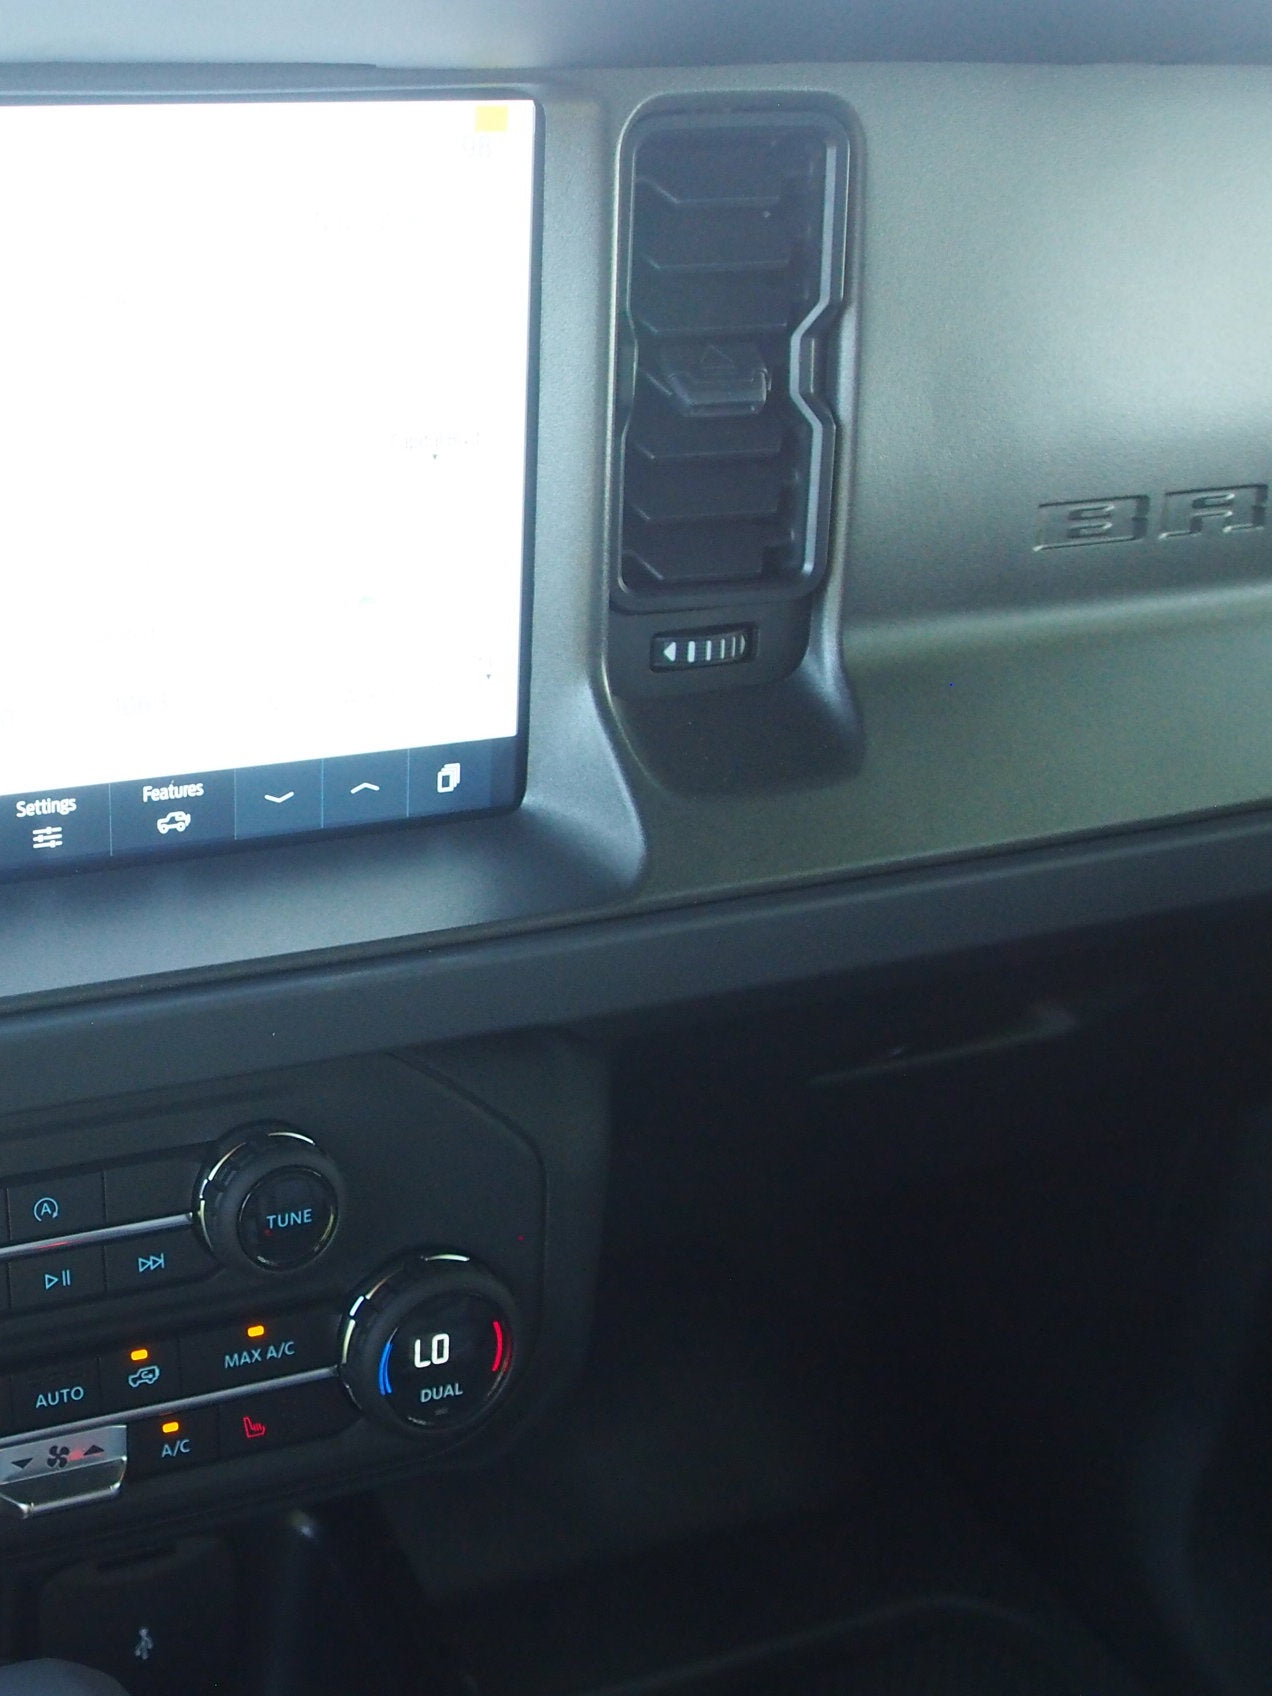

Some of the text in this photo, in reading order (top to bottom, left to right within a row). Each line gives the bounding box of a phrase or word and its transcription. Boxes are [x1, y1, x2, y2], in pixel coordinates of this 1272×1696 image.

[143, 780, 204, 803] Features
[16, 795, 77, 818] Settings
[266, 1208, 312, 1229] TUNE
[224, 1341, 295, 1368] MAX A/C
[414, 1333, 450, 1368] LO
[35, 1386, 84, 1408] AUTO
[420, 1382, 464, 1403] DUAL
[161, 1439, 190, 1458] A/C
